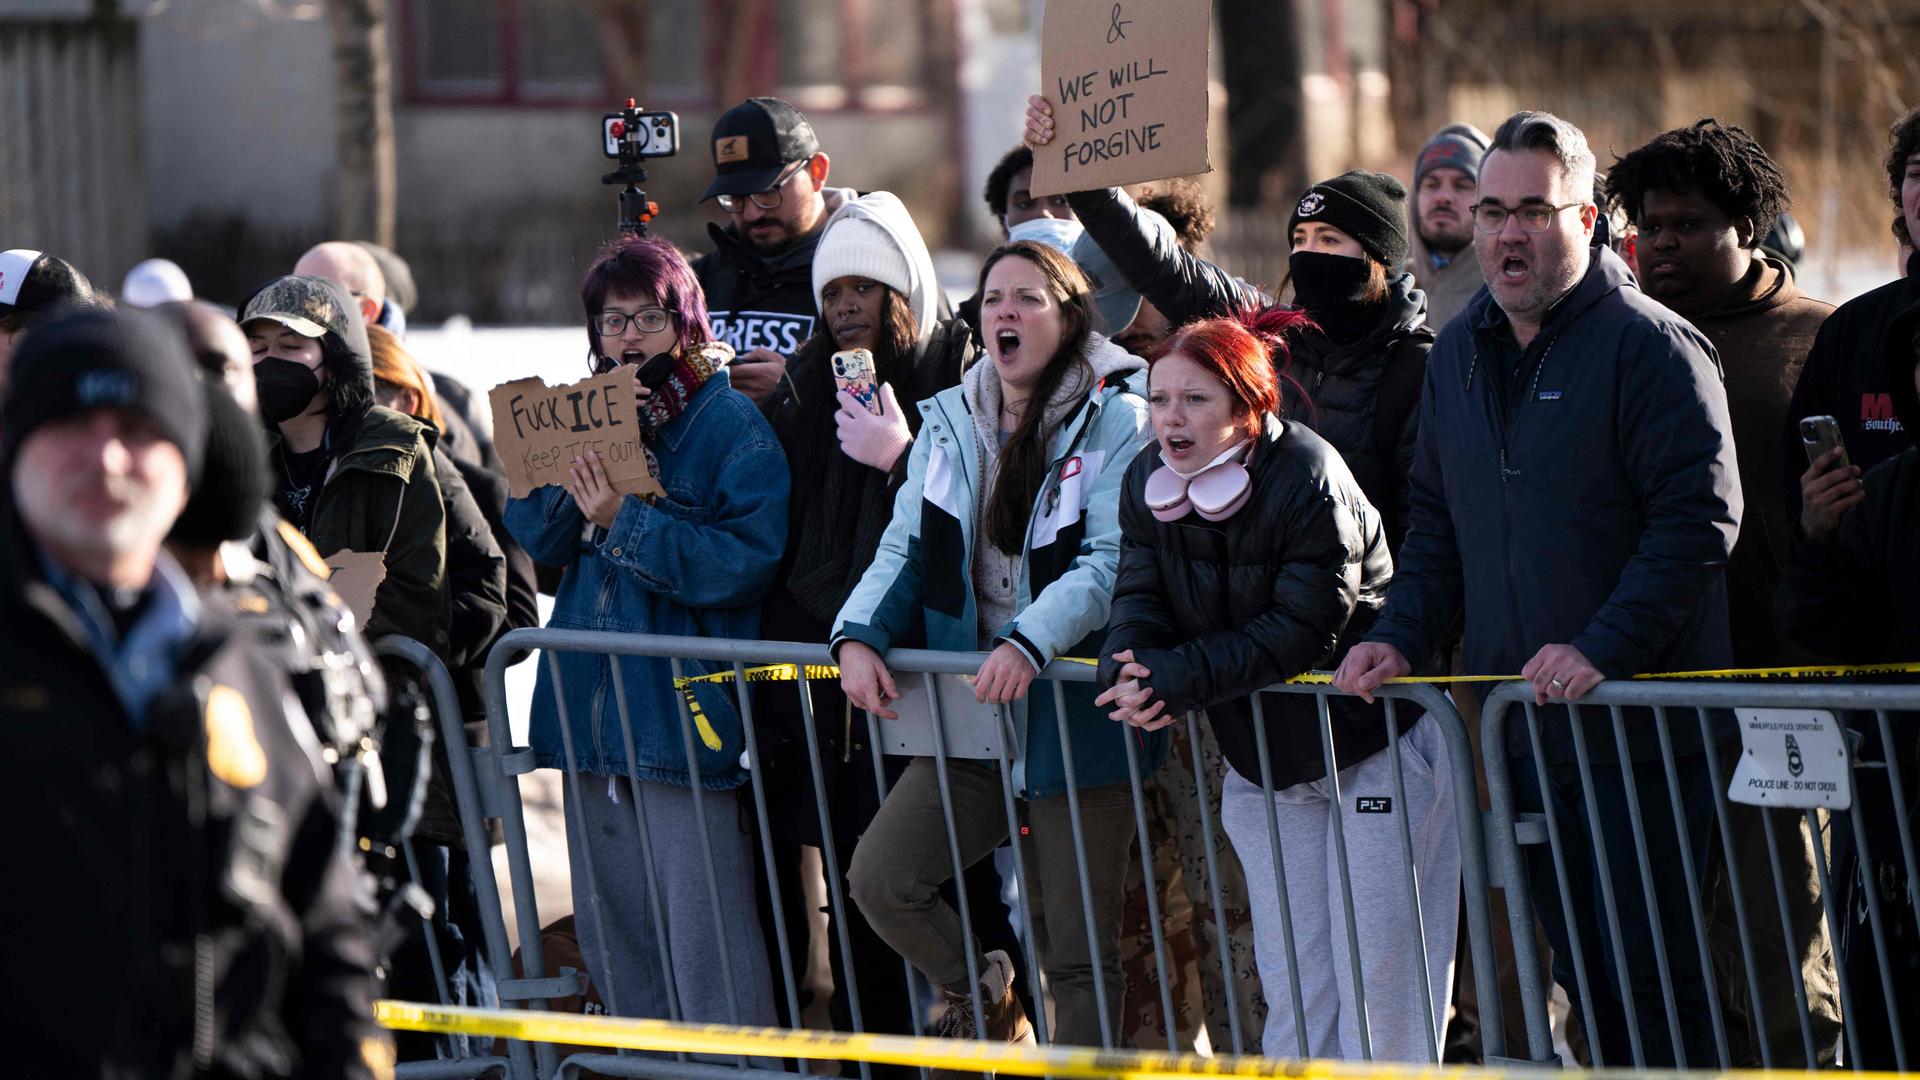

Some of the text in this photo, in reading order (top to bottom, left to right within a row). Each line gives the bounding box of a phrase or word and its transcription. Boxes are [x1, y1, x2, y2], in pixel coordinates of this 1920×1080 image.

[1107, 3, 1132, 43] &
[1058, 58, 1168, 104] WE WILL
[1081, 93, 1134, 132] NOT
[1063, 123, 1165, 172] FORGIVE
[711, 318, 800, 355] PRESS
[510, 384, 622, 439] FUCK ICE
[609, 437, 640, 464] OUT!
[1749, 778, 1775, 789] POLICE
[1776, 780, 1790, 790] LINE
[1794, 781, 1803, 791] DO
[1804, 781, 1816, 792] NOT
[1817, 782, 1838, 792] CROSS
[1360, 800, 1387, 810] PLT
